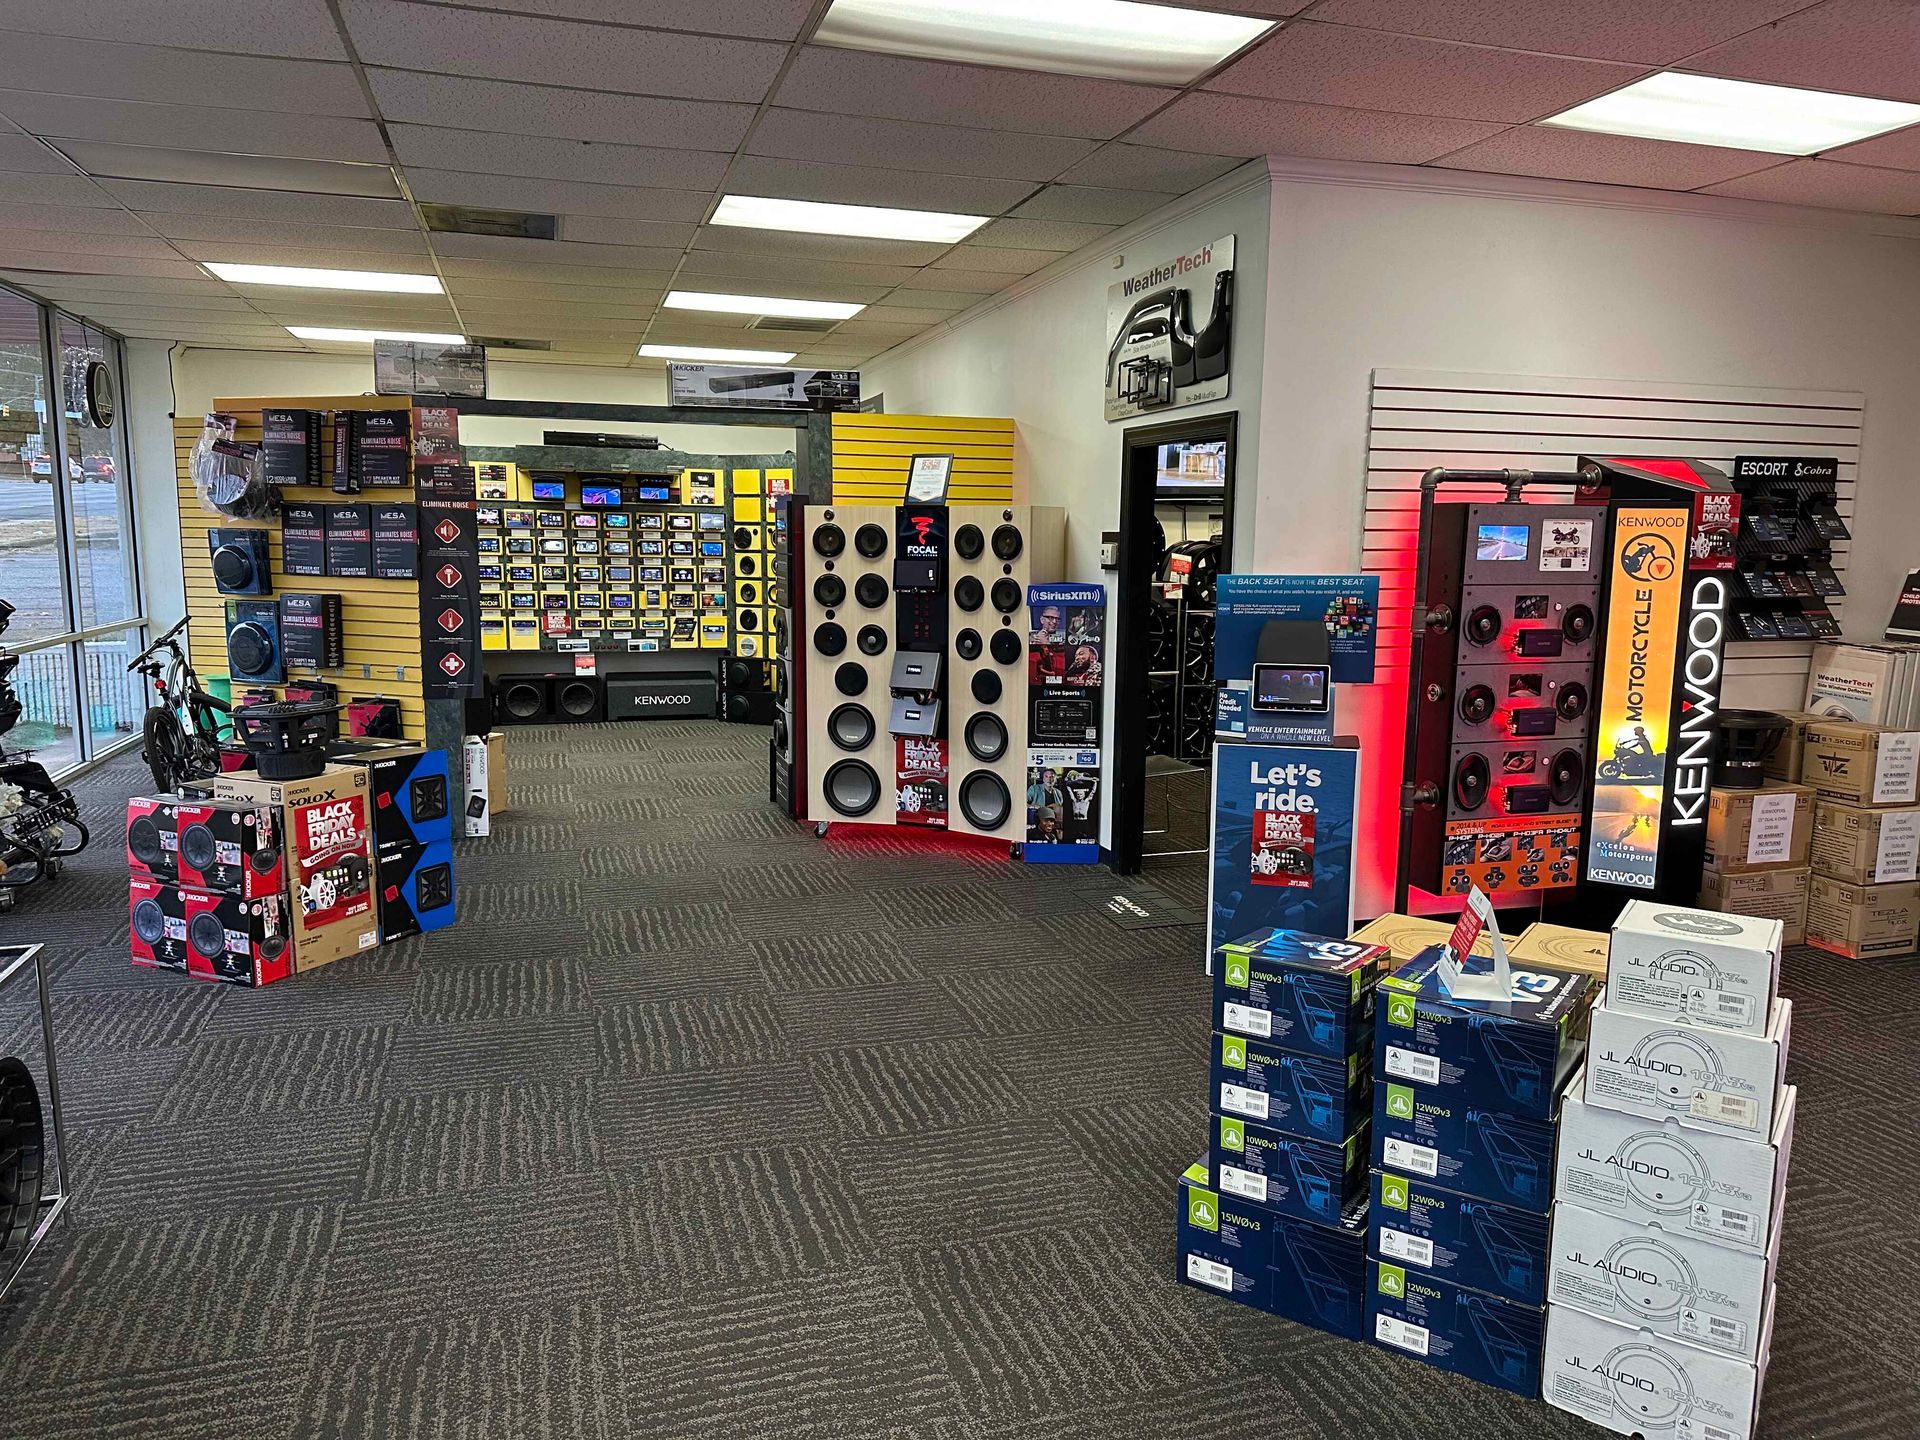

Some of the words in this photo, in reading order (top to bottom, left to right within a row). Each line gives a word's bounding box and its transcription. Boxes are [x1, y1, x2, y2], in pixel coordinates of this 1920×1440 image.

[1124, 246, 1212, 297] WeatherTech
[265, 431, 286, 439] ELIMINATES
[286, 432, 301, 440] NOISE
[361, 437, 386, 445] ELIMINATES
[387, 437, 401, 445] NOISE
[1741, 462, 1788, 476] ESCORT
[1795, 463, 1803, 476] &
[1804, 466, 1832, 475] Cobra
[1704, 496, 1730, 505] BLACK
[1703, 505, 1731, 514] FRIDAY
[1618, 517, 1685, 527] KENWOOD
[1702, 513, 1730, 522] DEALS
[907, 545, 937, 554] FOCAL
[1039, 590, 1092, 600] SiriusXM
[283, 615, 304, 623] ELIMINATES
[305, 616, 318, 624] NOISE
[1626, 588, 1654, 722] MOTORCYCLE
[1817, 674, 1873, 688] WeatherTech
[1847, 687, 1871, 695] Deflectors
[634, 696, 691, 705] KENWOOD
[1219, 698, 1236, 706] Credit
[1672, 576, 1724, 826] KENWOOD
[1218, 704, 1241, 712] Needed
[1274, 727, 1327, 735] ENTERTAINMENT
[905, 750, 941, 761] FRIDAY
[1031, 755, 1044, 765] $5
[905, 759, 941, 772] DEALS
[288, 787, 309, 795] KICKER
[129, 800, 150, 808] KICKER
[1256, 788, 1319, 813] ride.
[179, 806, 201, 814] KICKER
[307, 801, 352, 824] BLACK
[1265, 813, 1301, 823] BLACK
[308, 814, 355, 837] FRIDAY
[1265, 822, 1303, 832] FRIDAY
[1456, 827, 1484, 835] SYSTEMS
[310, 827, 356, 850] DEALS
[1265, 831, 1302, 842] DEALS
[1596, 842, 1635, 851] eXcelon
[310, 849, 331, 863] GOING
[331, 845, 341, 854] ON
[342, 842, 356, 851] NOW
[1600, 850, 1653, 861] Motorsports
[381, 853, 402, 864] KICKER
[1590, 868, 1655, 885] KENWOOD
[130, 882, 150, 890] KICKER
[186, 894, 208, 902] KICKER
[1872, 908, 1909, 916] TEZLA
[1628, 957, 1645, 967] JL
[1648, 961, 1696, 976] AUDIO
[1600, 1051, 1620, 1063] JL
[1624, 1056, 1683, 1076] AUDIO
[1577, 1149, 1600, 1163] JL
[1605, 1155, 1670, 1180] AUDIO
[1566, 1252, 1589, 1267] JL
[1593, 1259, 1658, 1285] AUDIO
[1565, 1356, 1587, 1371] JL
[1591, 1364, 1655, 1393] AUDIO
